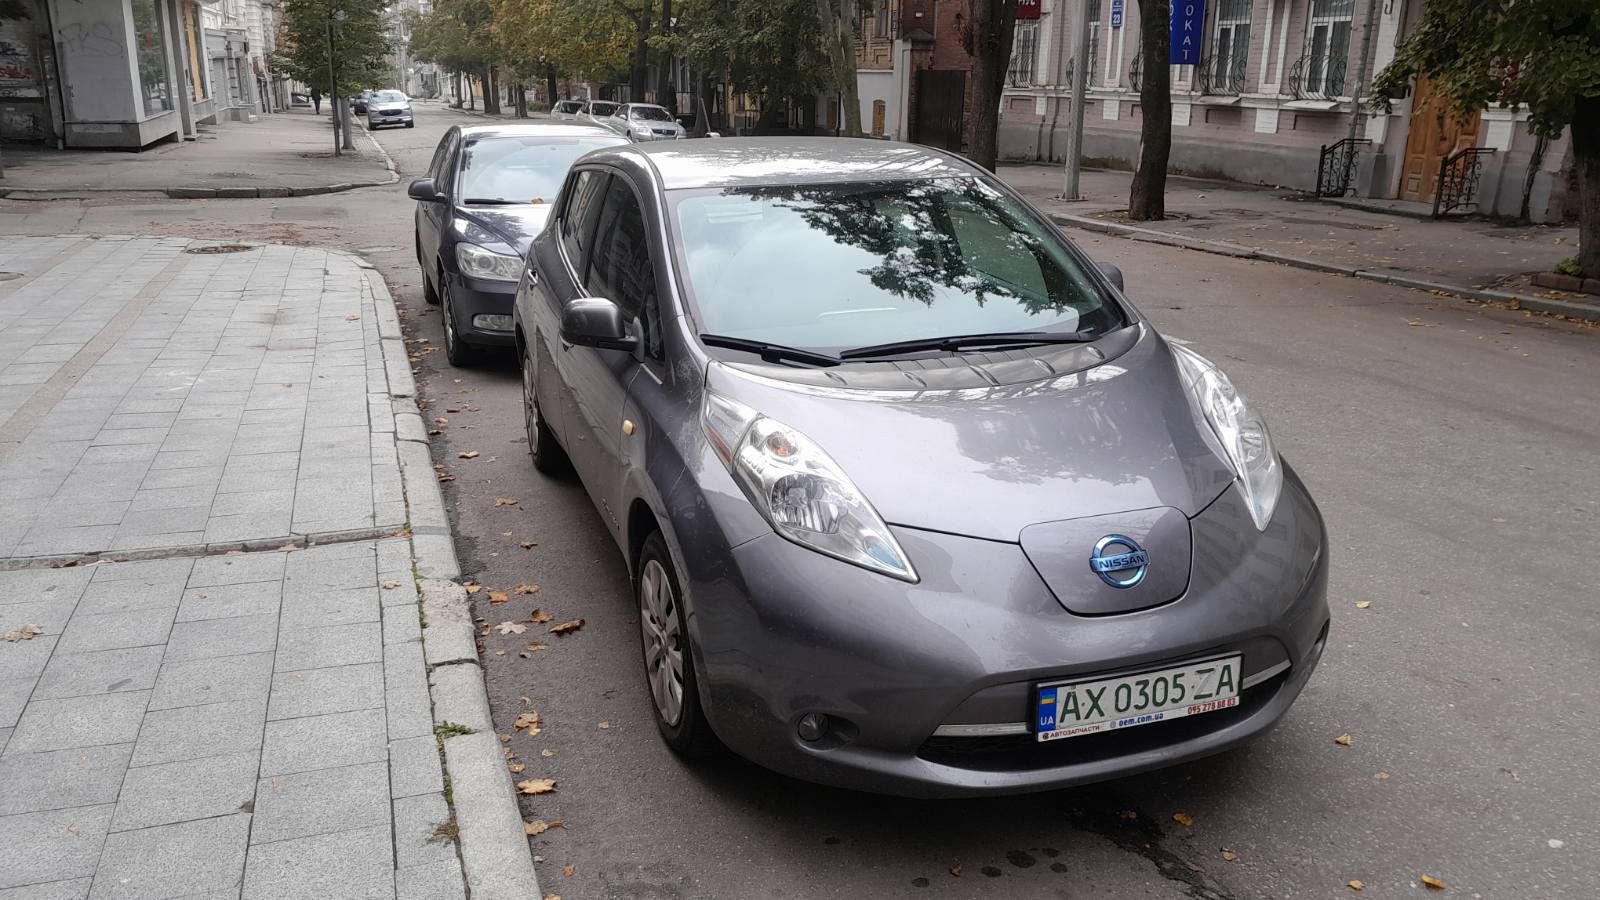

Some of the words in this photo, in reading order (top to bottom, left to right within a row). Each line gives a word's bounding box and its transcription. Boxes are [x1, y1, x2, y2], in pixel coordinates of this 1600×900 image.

[1113, 14, 1120, 24] 23
[1182, 0, 1194, 61] ОКАТ
[1098, 554, 1145, 569] NISSAN
[1059, 686, 1107, 723] AX
[1114, 673, 1186, 713] 0305
[1194, 663, 1234, 700] ZA
[1040, 716, 1054, 726] UA
[1050, 726, 1100, 738] АВТОЗАПЧАСТИ
[1119, 713, 1164, 727] oem.com.ua
[1187, 705, 1201, 714] 095
